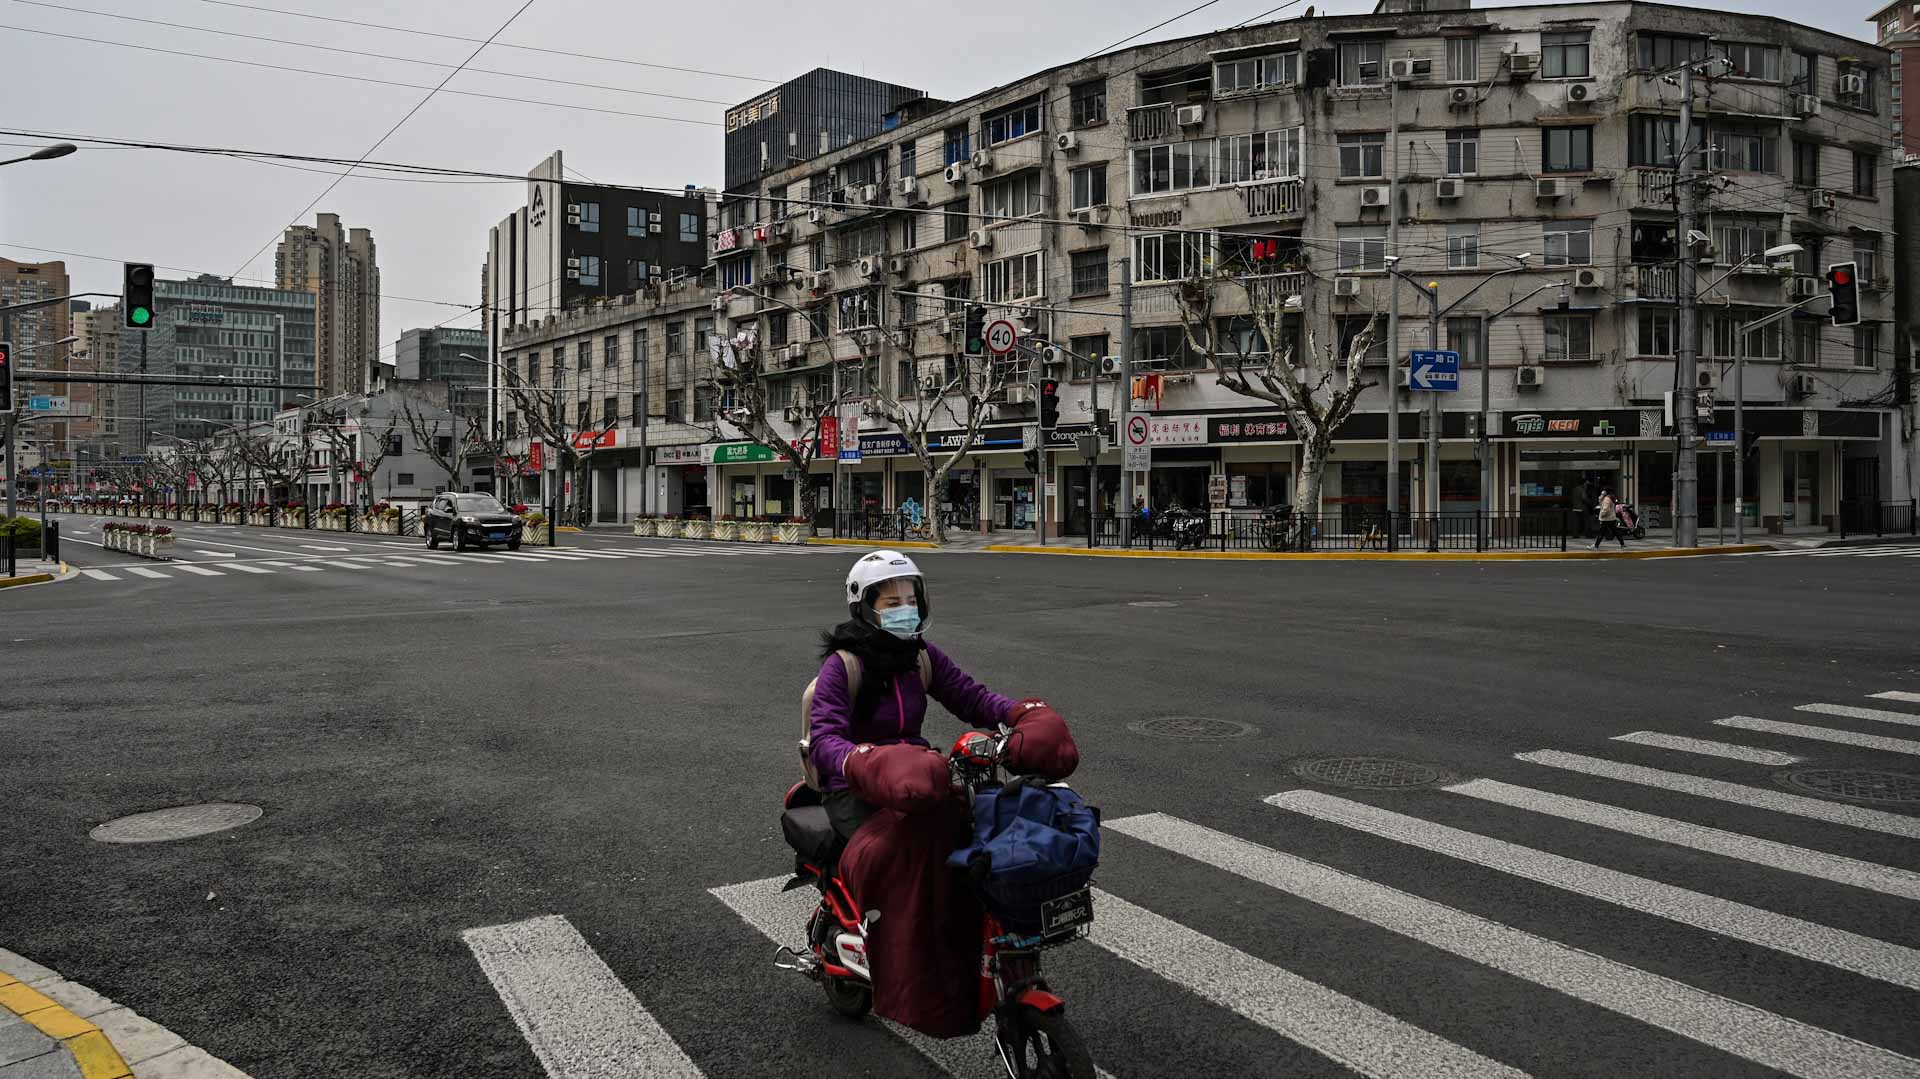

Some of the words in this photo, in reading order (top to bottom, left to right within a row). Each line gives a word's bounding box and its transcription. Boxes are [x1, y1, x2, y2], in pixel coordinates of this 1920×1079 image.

[991, 329, 1011, 346] 40
[1415, 353, 1455, 363] 下一路口
[1218, 423, 1240, 437] 福利
[1244, 422, 1288, 436] 体育彩票
[1547, 419, 1580, 432] KEDI
